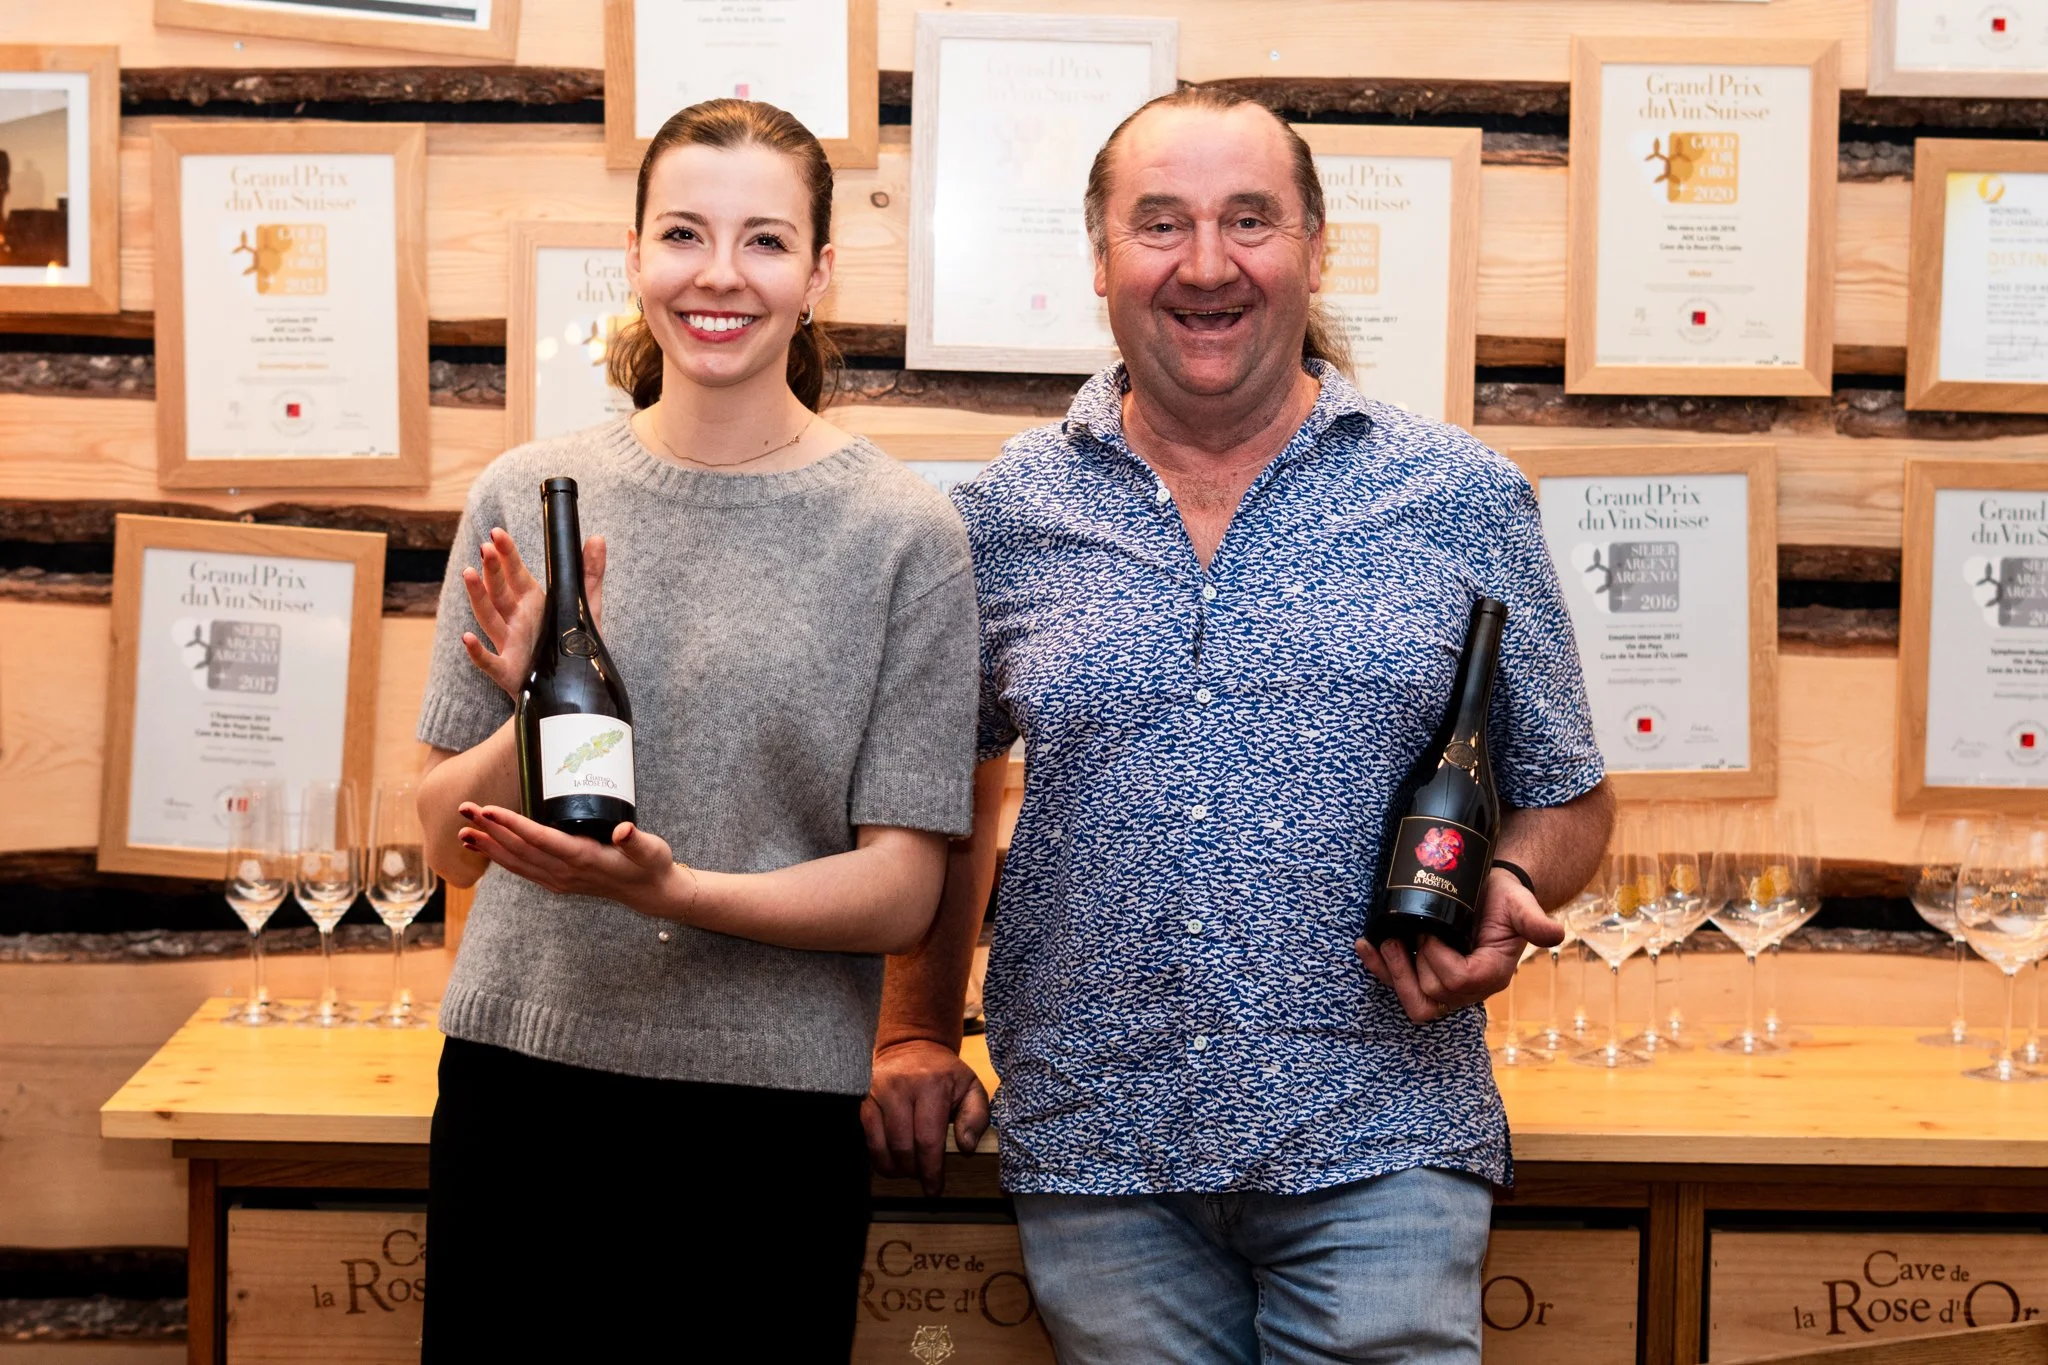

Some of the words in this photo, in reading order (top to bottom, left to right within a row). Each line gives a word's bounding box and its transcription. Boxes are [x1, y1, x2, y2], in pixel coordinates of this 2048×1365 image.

[1059, 57, 1103, 81] Prix
[1647, 73, 1714, 97] Grand
[1718, 75, 1764, 97] Prix
[1703, 100, 1770, 121] Suisse
[231, 164, 299, 187] Grand
[305, 164, 348, 187] Prix
[1359, 164, 1404, 187] Prix
[290, 190, 357, 211] Suisse
[1345, 190, 1411, 211] Suisse
[1693, 184, 1734, 202] 2020
[1585, 484, 1653, 506] Grand
[1658, 484, 1701, 505] Prix
[1643, 510, 1710, 530] Suisse
[1979, 499, 2047, 522] Grand
[1631, 543, 1676, 557] SILBER
[1623, 557, 1675, 570] ARGENT
[190, 561, 259, 586] Grand
[263, 565, 306, 589] Prix
[1614, 570, 1677, 584] ARGENTO
[247, 588, 314, 613] Suisse
[1640, 594, 1677, 611] 2016
[226, 637, 278, 651] ARGENT
[212, 649, 279, 665] ARGENTO
[238, 674, 277, 692] 2017
[877, 1239, 960, 1278] Cave
[964, 1255, 985, 1273] de
[1863, 1250, 1945, 1288] Cave
[1949, 1265, 1969, 1283] de
[312, 1284, 336, 1309] la
[341, 1258, 426, 1315] Ros
[857, 1268, 945, 1323] Rose
[954, 1271, 1036, 1327] d'O
[1793, 1306, 1816, 1329] la
[1822, 1279, 1931, 1336] Rose
[1938, 1280, 2041, 1328] d'Or
